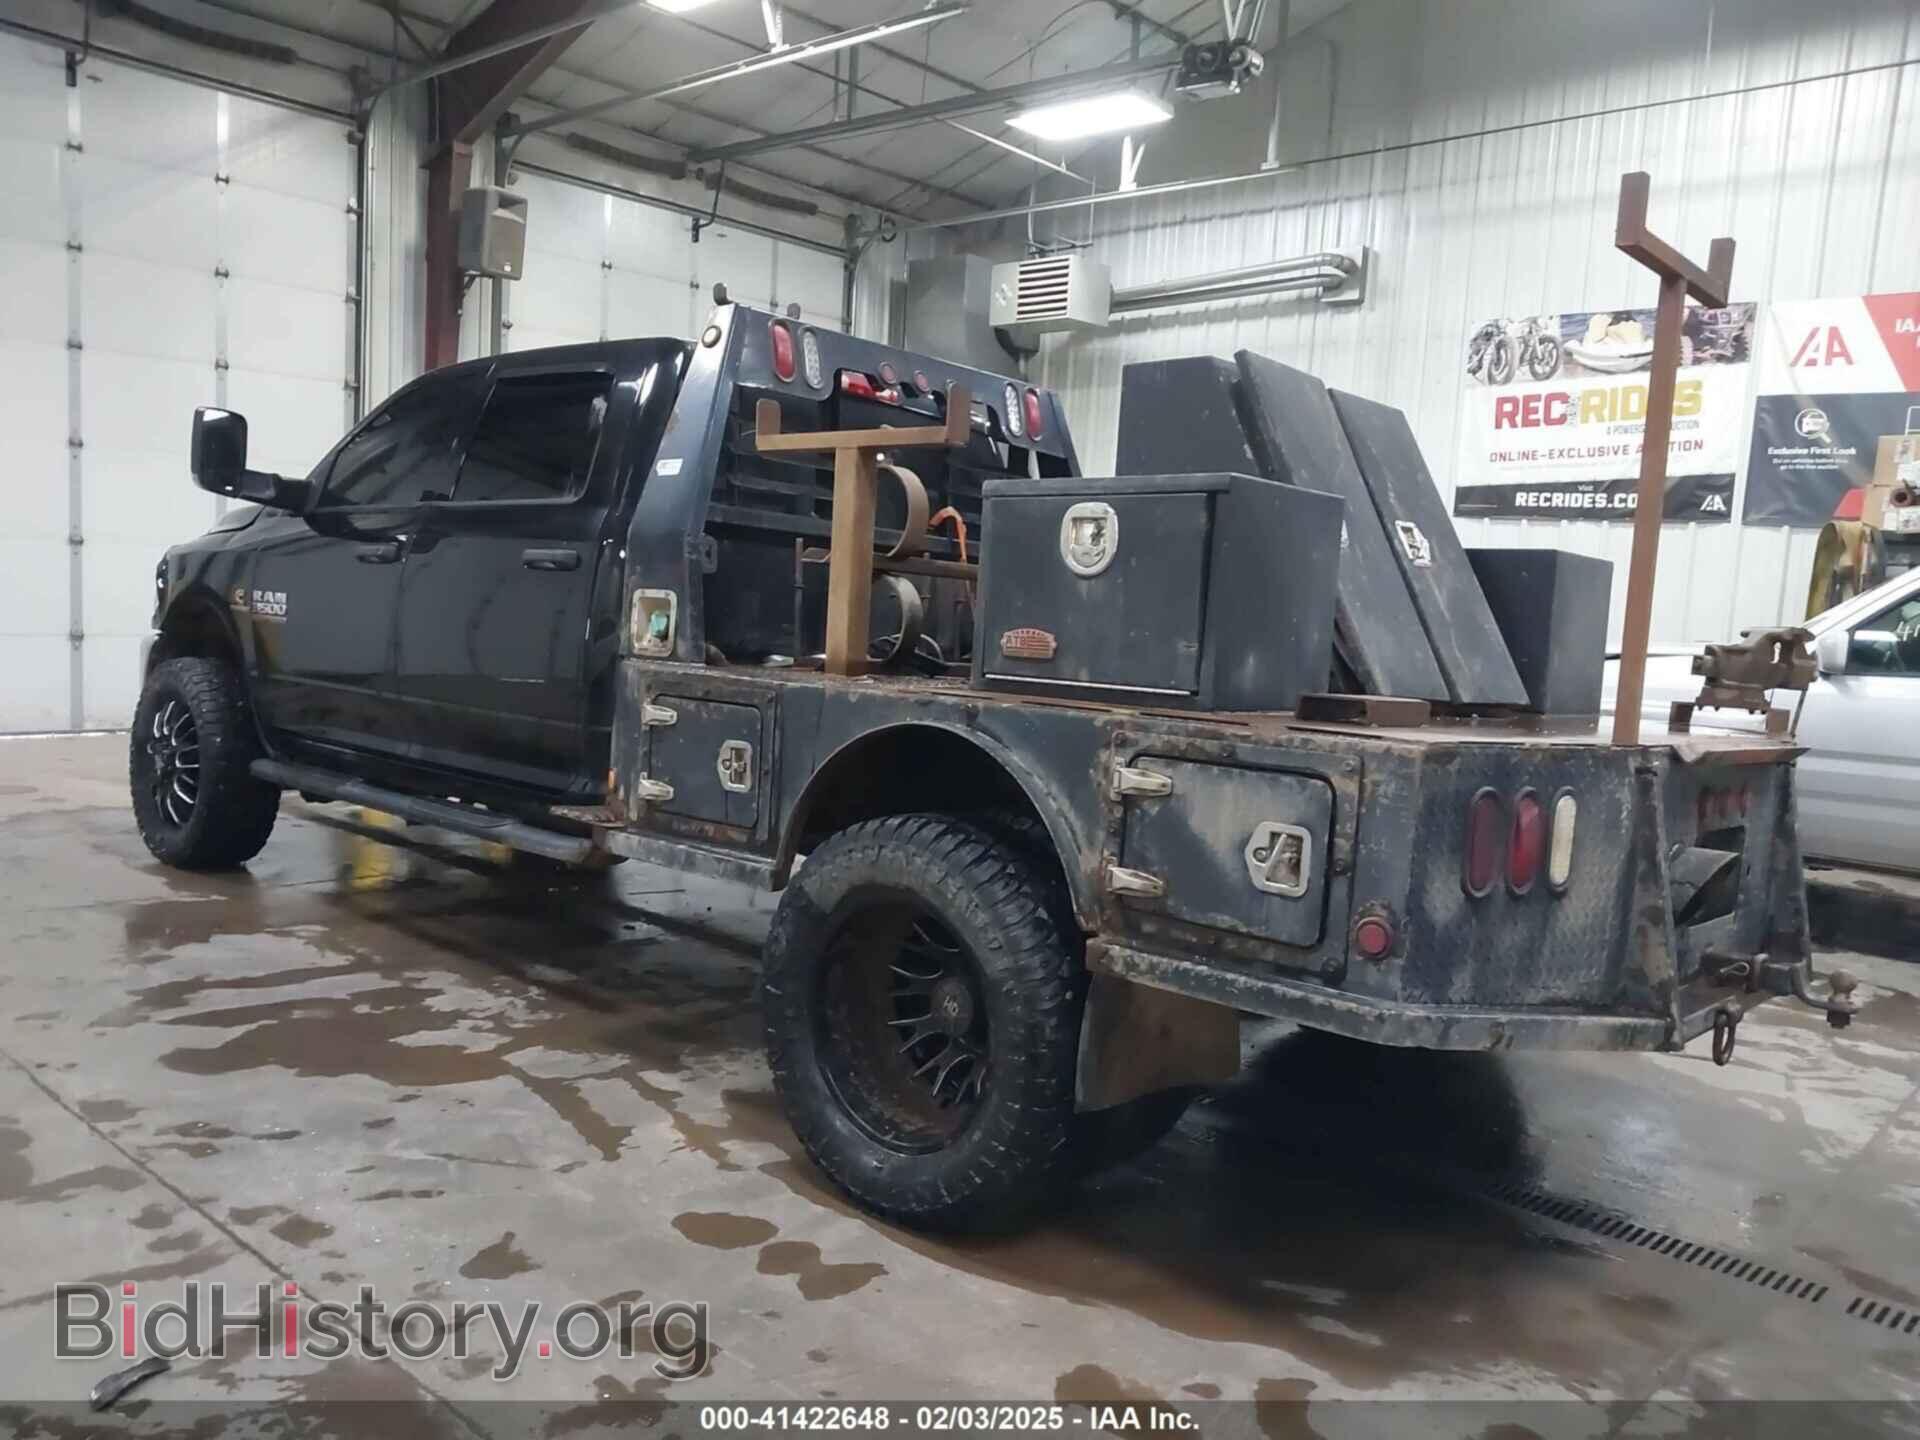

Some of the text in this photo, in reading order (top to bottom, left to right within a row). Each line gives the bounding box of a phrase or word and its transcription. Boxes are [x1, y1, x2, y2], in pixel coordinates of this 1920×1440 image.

[1495, 392, 1570, 430] REC
[1580, 381, 1703, 424] RIDS
[1489, 439, 1704, 463] ONLINE-EXCLUSIVE ATION
[1515, 492, 1638, 508] RECRIDES.CO
[252, 590, 287, 603] RAM
